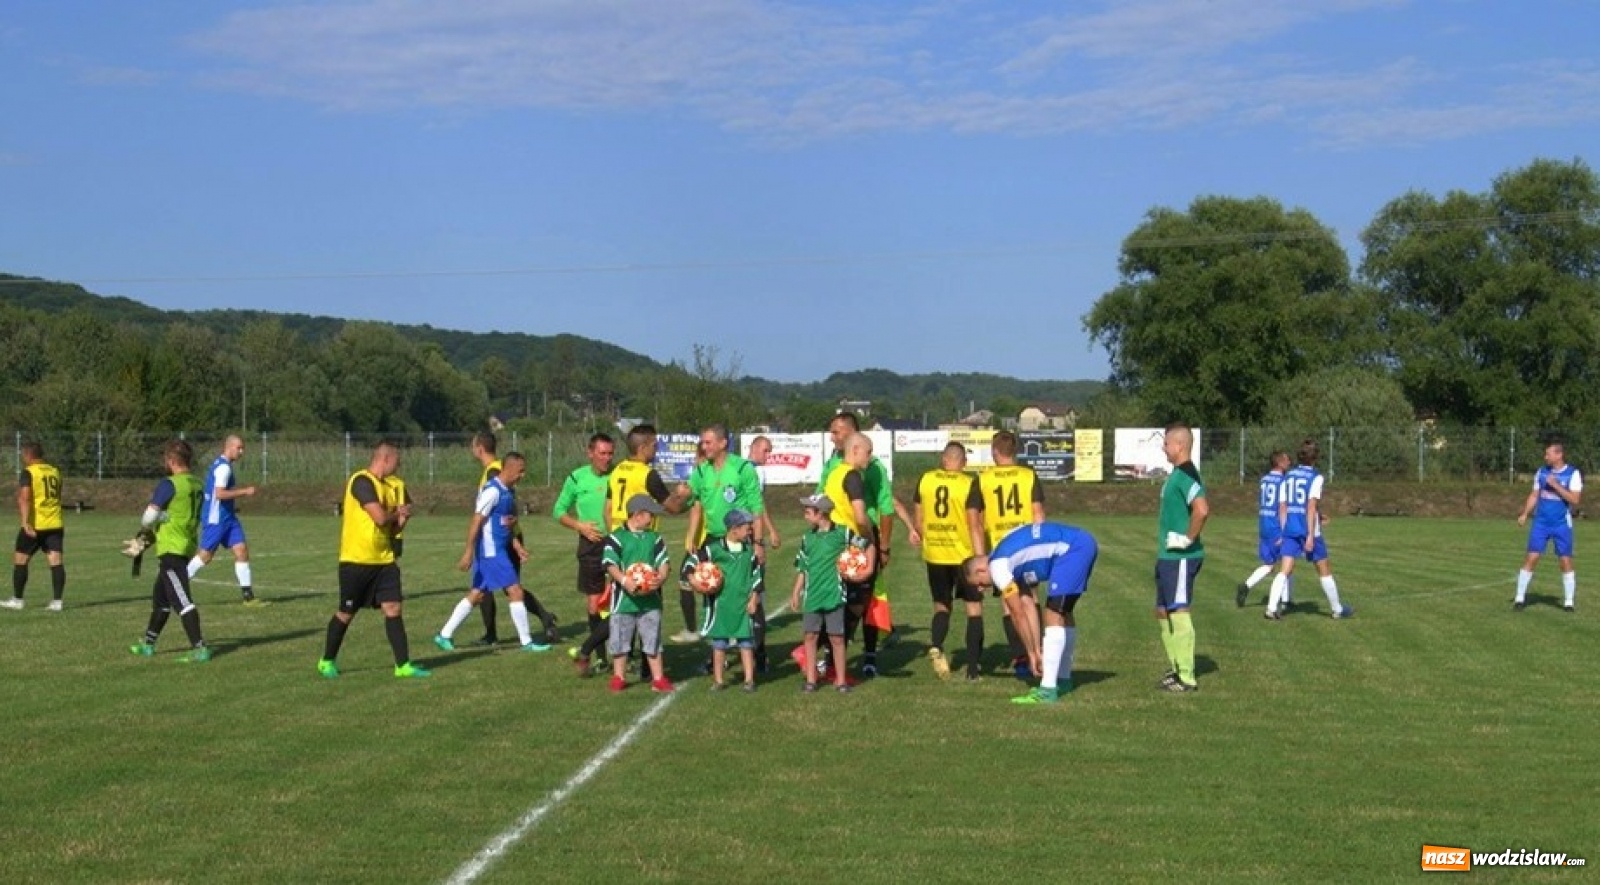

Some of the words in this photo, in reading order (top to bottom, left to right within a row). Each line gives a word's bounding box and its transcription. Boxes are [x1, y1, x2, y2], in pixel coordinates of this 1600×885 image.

[41, 475, 60, 499] 19
[617, 477, 627, 511] 7
[934, 484, 949, 519] 8
[993, 482, 1024, 517] 14
[1260, 482, 1276, 507] 19
